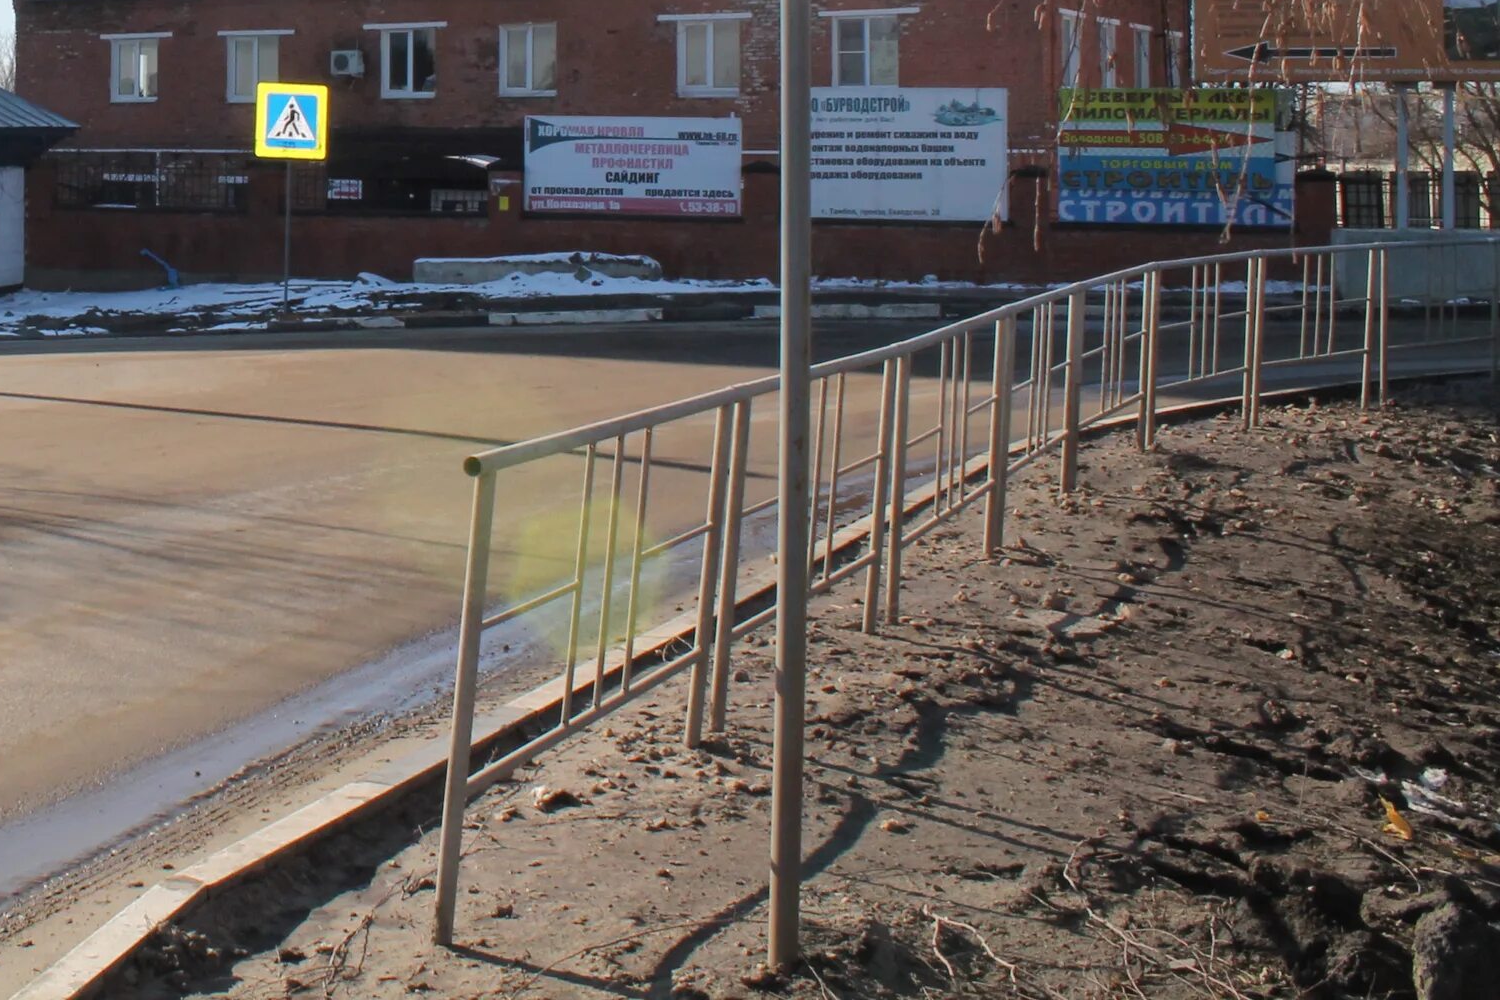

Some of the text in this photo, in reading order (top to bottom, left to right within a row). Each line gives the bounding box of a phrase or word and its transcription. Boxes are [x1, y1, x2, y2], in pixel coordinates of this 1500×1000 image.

[821, 95, 910, 114] «БУРВОДСТРОЙ»
[538, 125, 644, 137] ХОРОШАЯ КРОВЛЯ
[855, 131, 891, 140] ремонт
[893, 131, 939, 140] скважин
[940, 132, 952, 140] на
[954, 132, 979, 141] воду
[574, 143, 690, 156] МЕТАЛЛОЧЕРЕПИЦА
[811, 144, 954, 154] онтаж водонапорных башен
[592, 157, 673, 169] ПРОФНАСТИЛ
[856, 157, 928, 167] оборудования
[930, 158, 942, 166] на
[944, 157, 986, 167] объекте
[605, 170, 660, 184] САЙДИНГ
[851, 170, 923, 180] оборудования
[1062, 170, 1273, 190] СТРОИТЕЛЬ
[544, 187, 623, 196] производителя
[645, 189, 700, 198] продается
[702, 189, 734, 198] здесь
[1059, 200, 1294, 224] СТРОИТЕЛЬ
